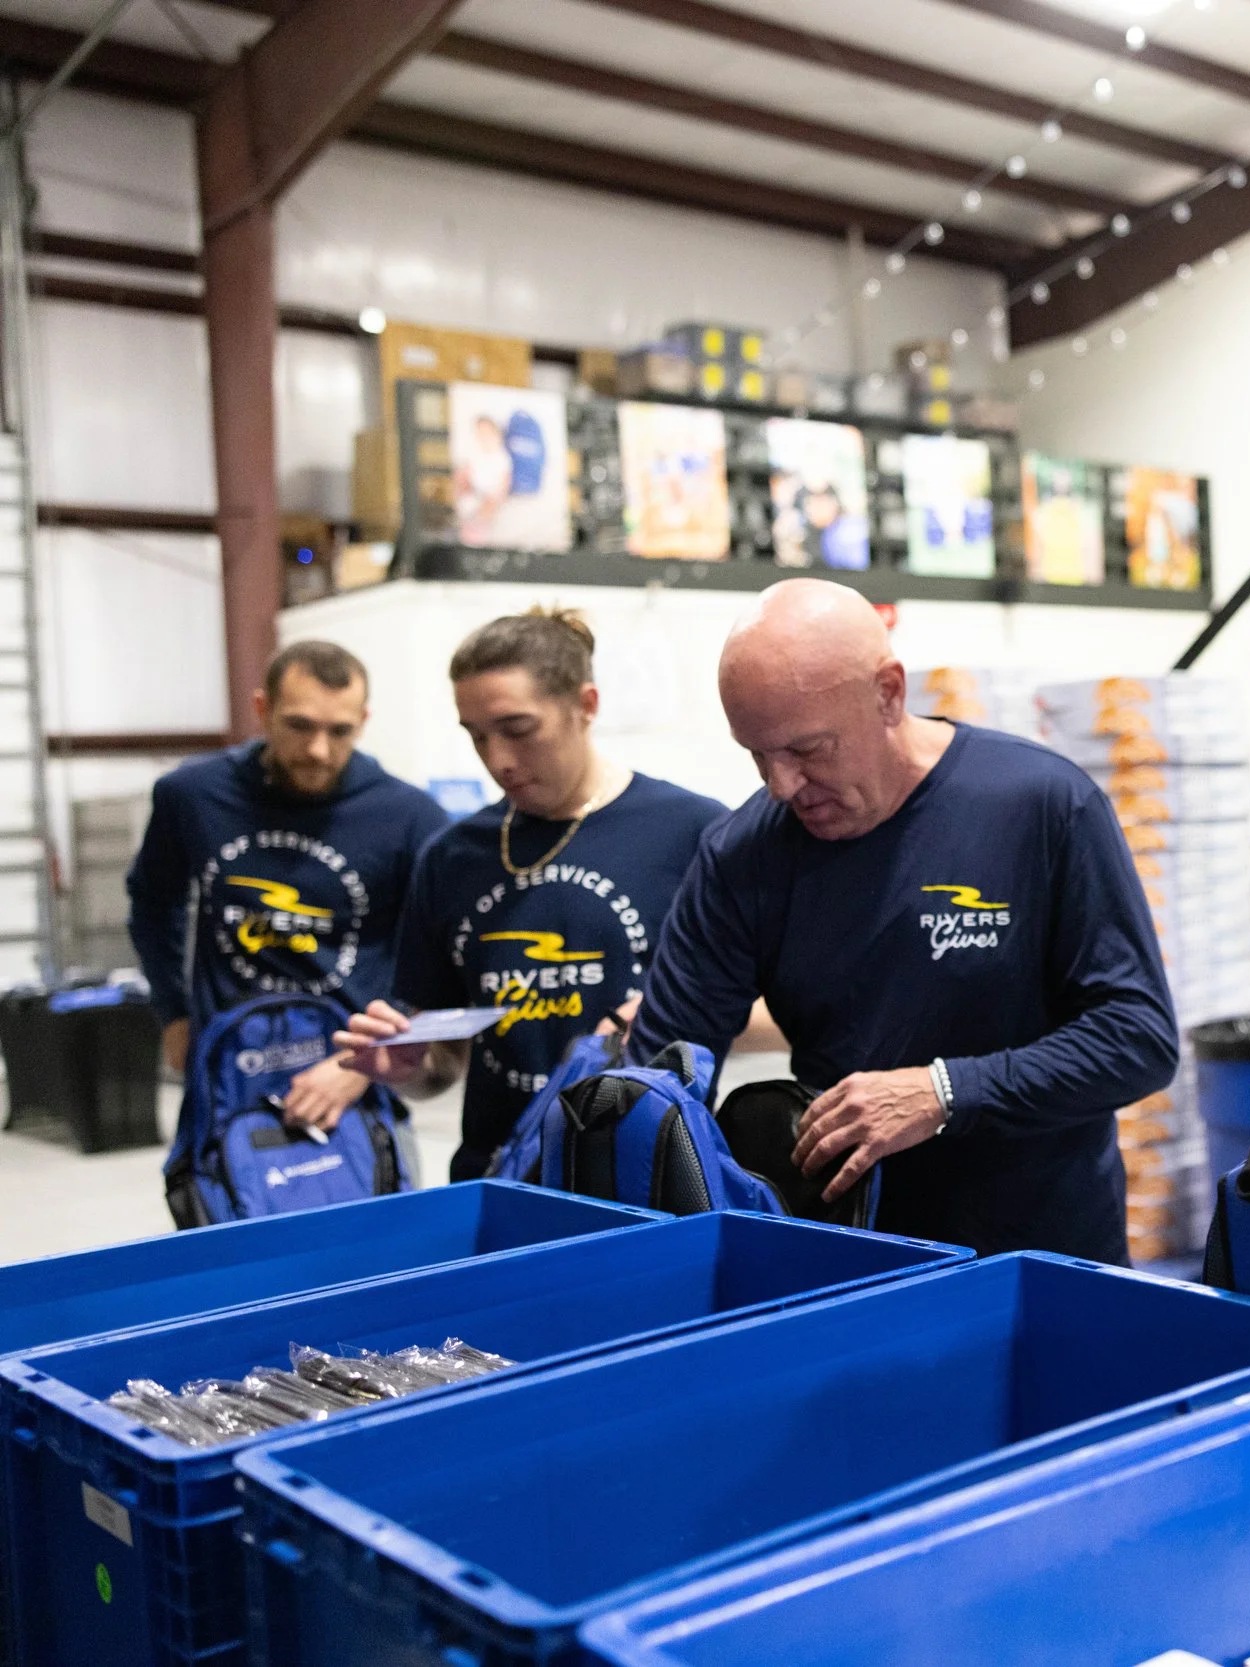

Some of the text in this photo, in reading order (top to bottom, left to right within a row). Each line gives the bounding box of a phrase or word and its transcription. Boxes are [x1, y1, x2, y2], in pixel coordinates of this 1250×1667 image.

[514, 863, 616, 899] SERVICE
[920, 911, 1011, 928] RIVERS
[930, 923, 998, 961] Gives
[480, 962, 605, 994] RIVERS
